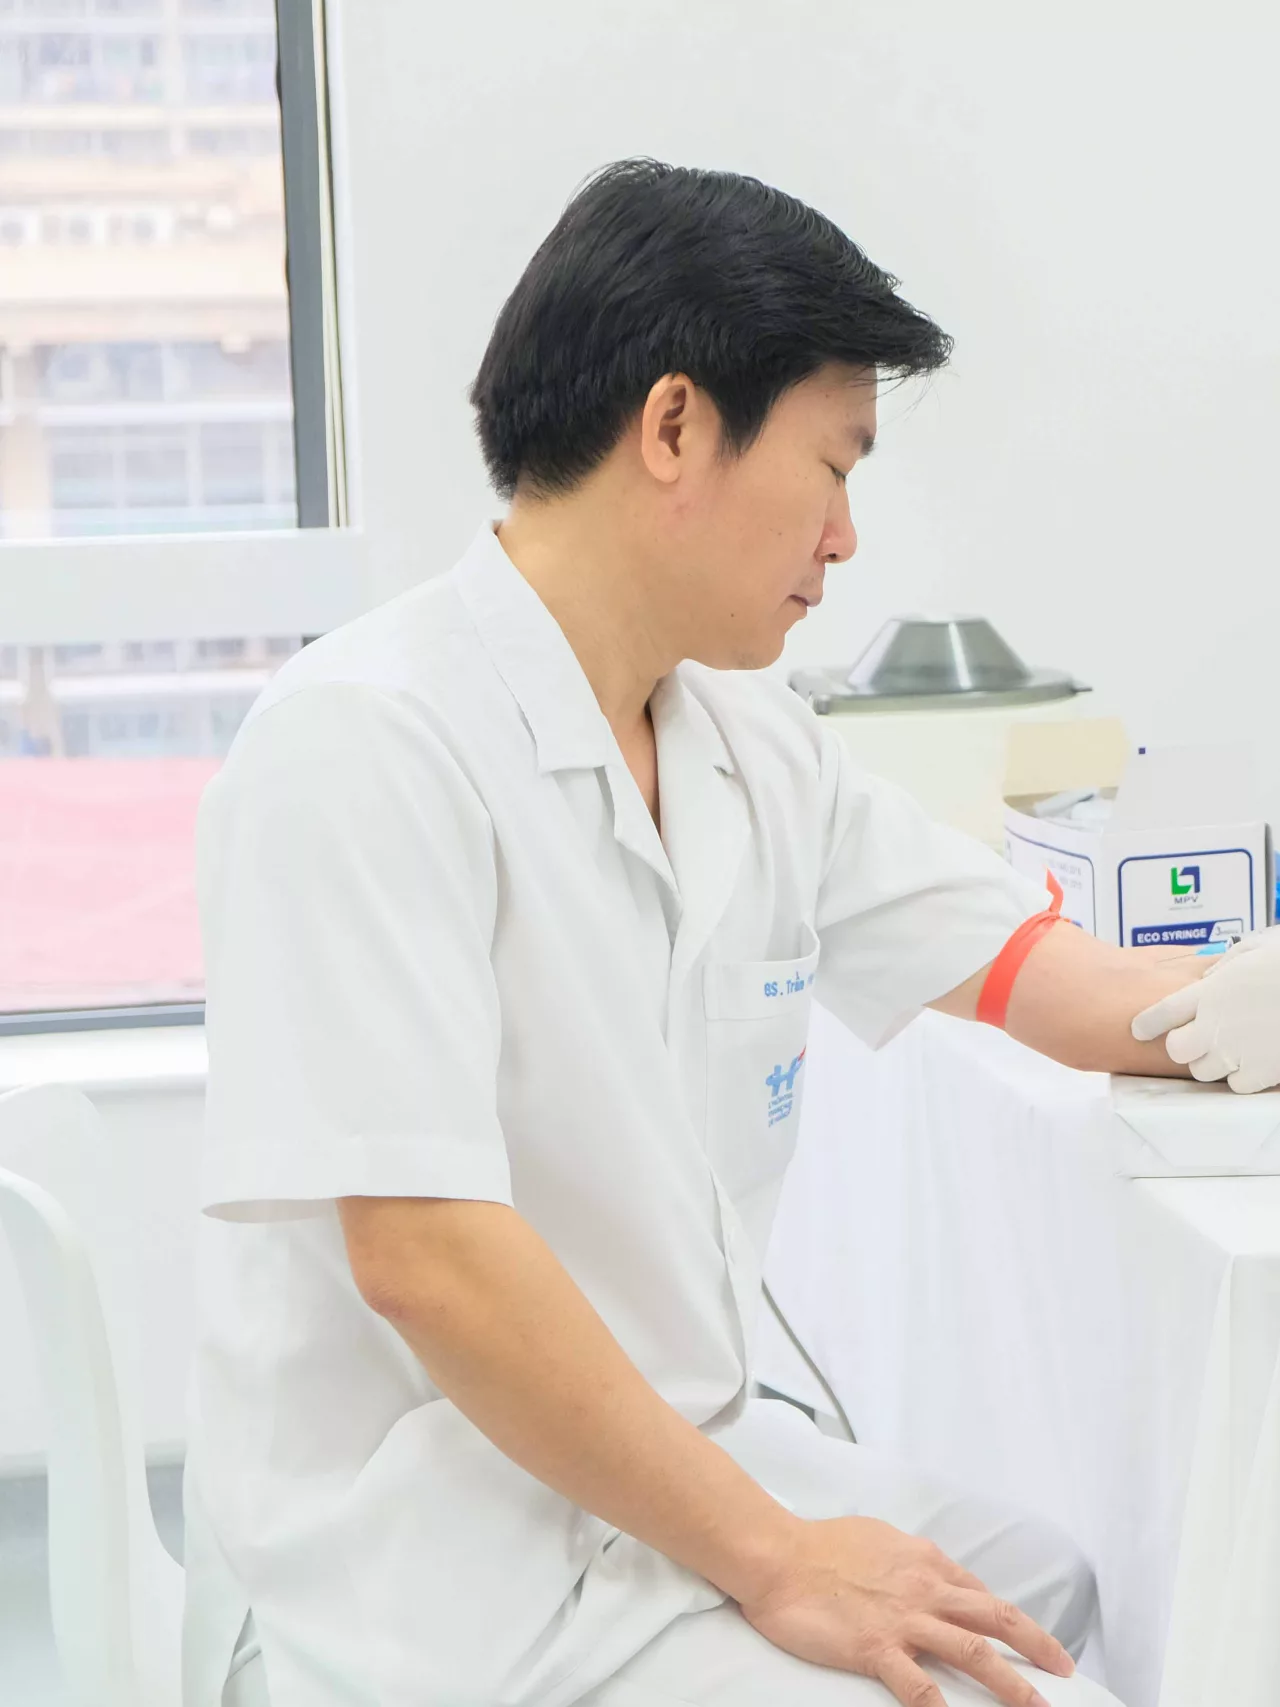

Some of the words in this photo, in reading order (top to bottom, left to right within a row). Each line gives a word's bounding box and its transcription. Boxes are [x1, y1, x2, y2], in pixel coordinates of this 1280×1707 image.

[1174, 895, 1199, 905] MPV
[1137, 931, 1161, 944] ECO
[1162, 927, 1208, 942] SYRINGE
